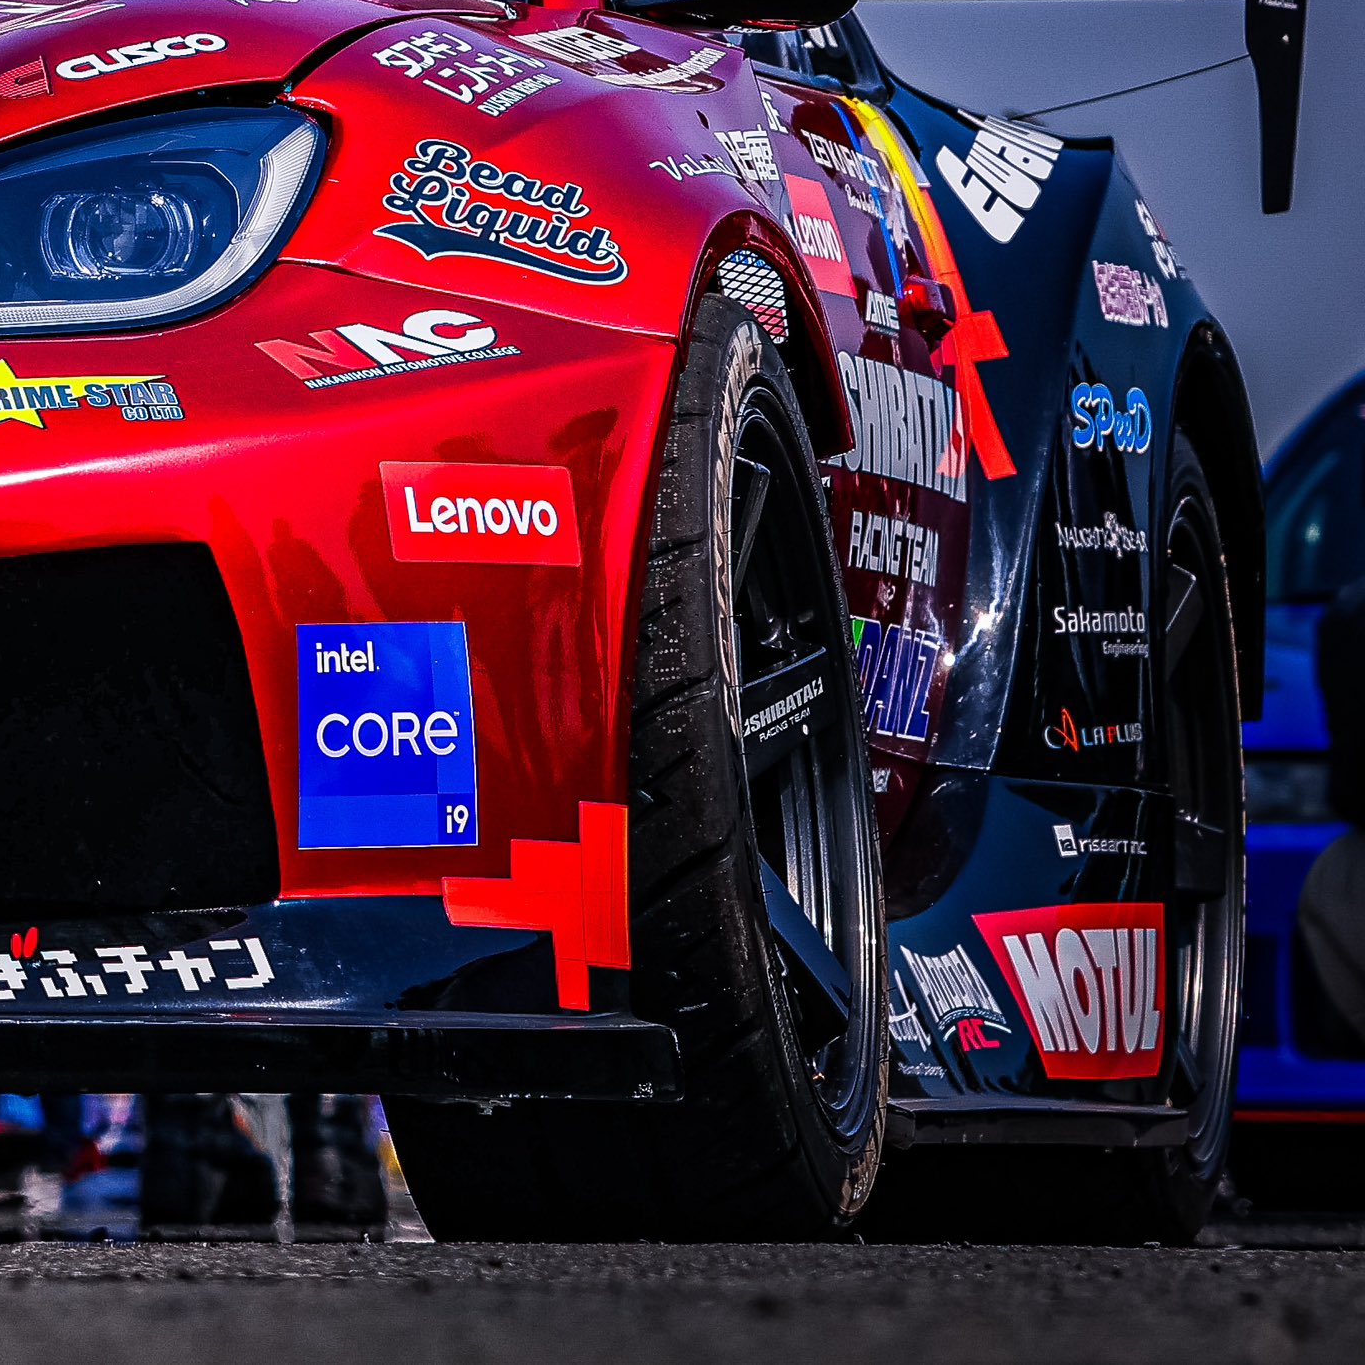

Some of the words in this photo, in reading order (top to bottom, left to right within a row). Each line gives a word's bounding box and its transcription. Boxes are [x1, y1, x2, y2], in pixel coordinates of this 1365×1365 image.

[53, 32, 228, 81] CUSCO
[404, 139, 591, 218] Bead
[382, 172, 619, 265] Liquid
[796, 213, 844, 264] Lenovo
[253, 309, 497, 380] NAC
[304, 366, 383, 390] NAKANIHON
[381, 353, 467, 375] AUTOMOTIVE
[466, 344, 522, 361] COLLEGE
[83, 382, 180, 406] STAR
[122, 406, 149, 421] CO
[150, 405, 184, 421] LTD
[403, 485, 559, 538] Lenovo
[848, 508, 902, 576] RACING
[903, 523, 940, 588] TEAM
[1053, 604, 1147, 634] Sakamoto
[1102, 638, 1150, 658] Engineering
[445, 804, 470, 834] i9
[1001, 927, 1161, 1054] MOTUL
[958, 1018, 1002, 1052] RC
